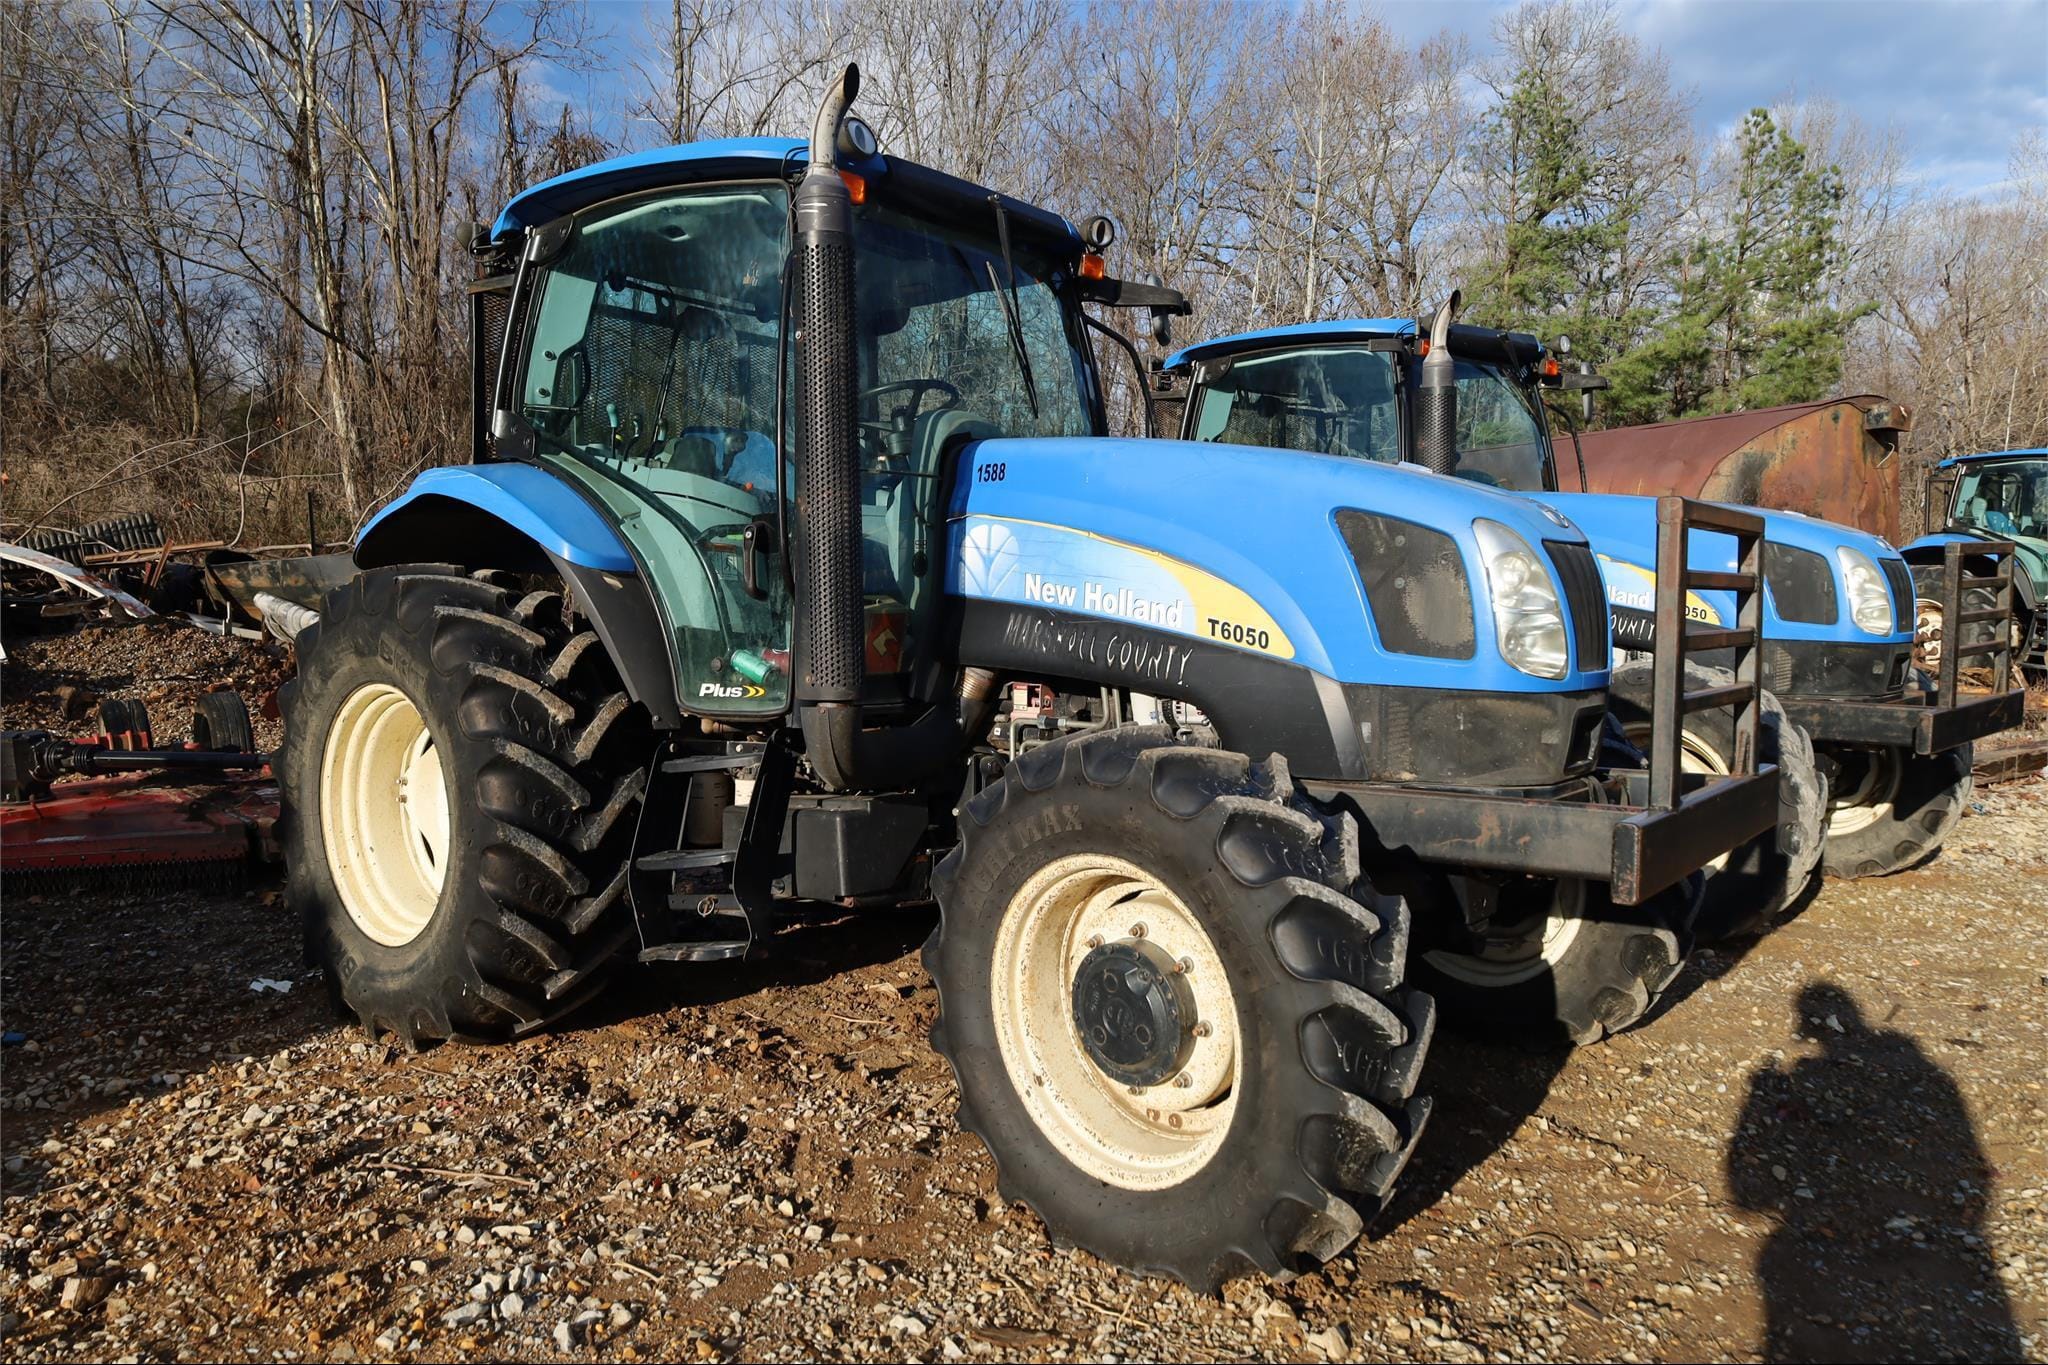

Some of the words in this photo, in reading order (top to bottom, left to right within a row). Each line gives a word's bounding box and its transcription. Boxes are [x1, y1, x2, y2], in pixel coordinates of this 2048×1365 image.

[977, 462, 1006, 483] 1588
[1024, 573, 1077, 607] New
[1084, 581, 1184, 629] Holland
[1207, 617, 1270, 650] T6050
[1106, 635, 1193, 681] COUNTY
[699, 683, 743, 698] Plus
